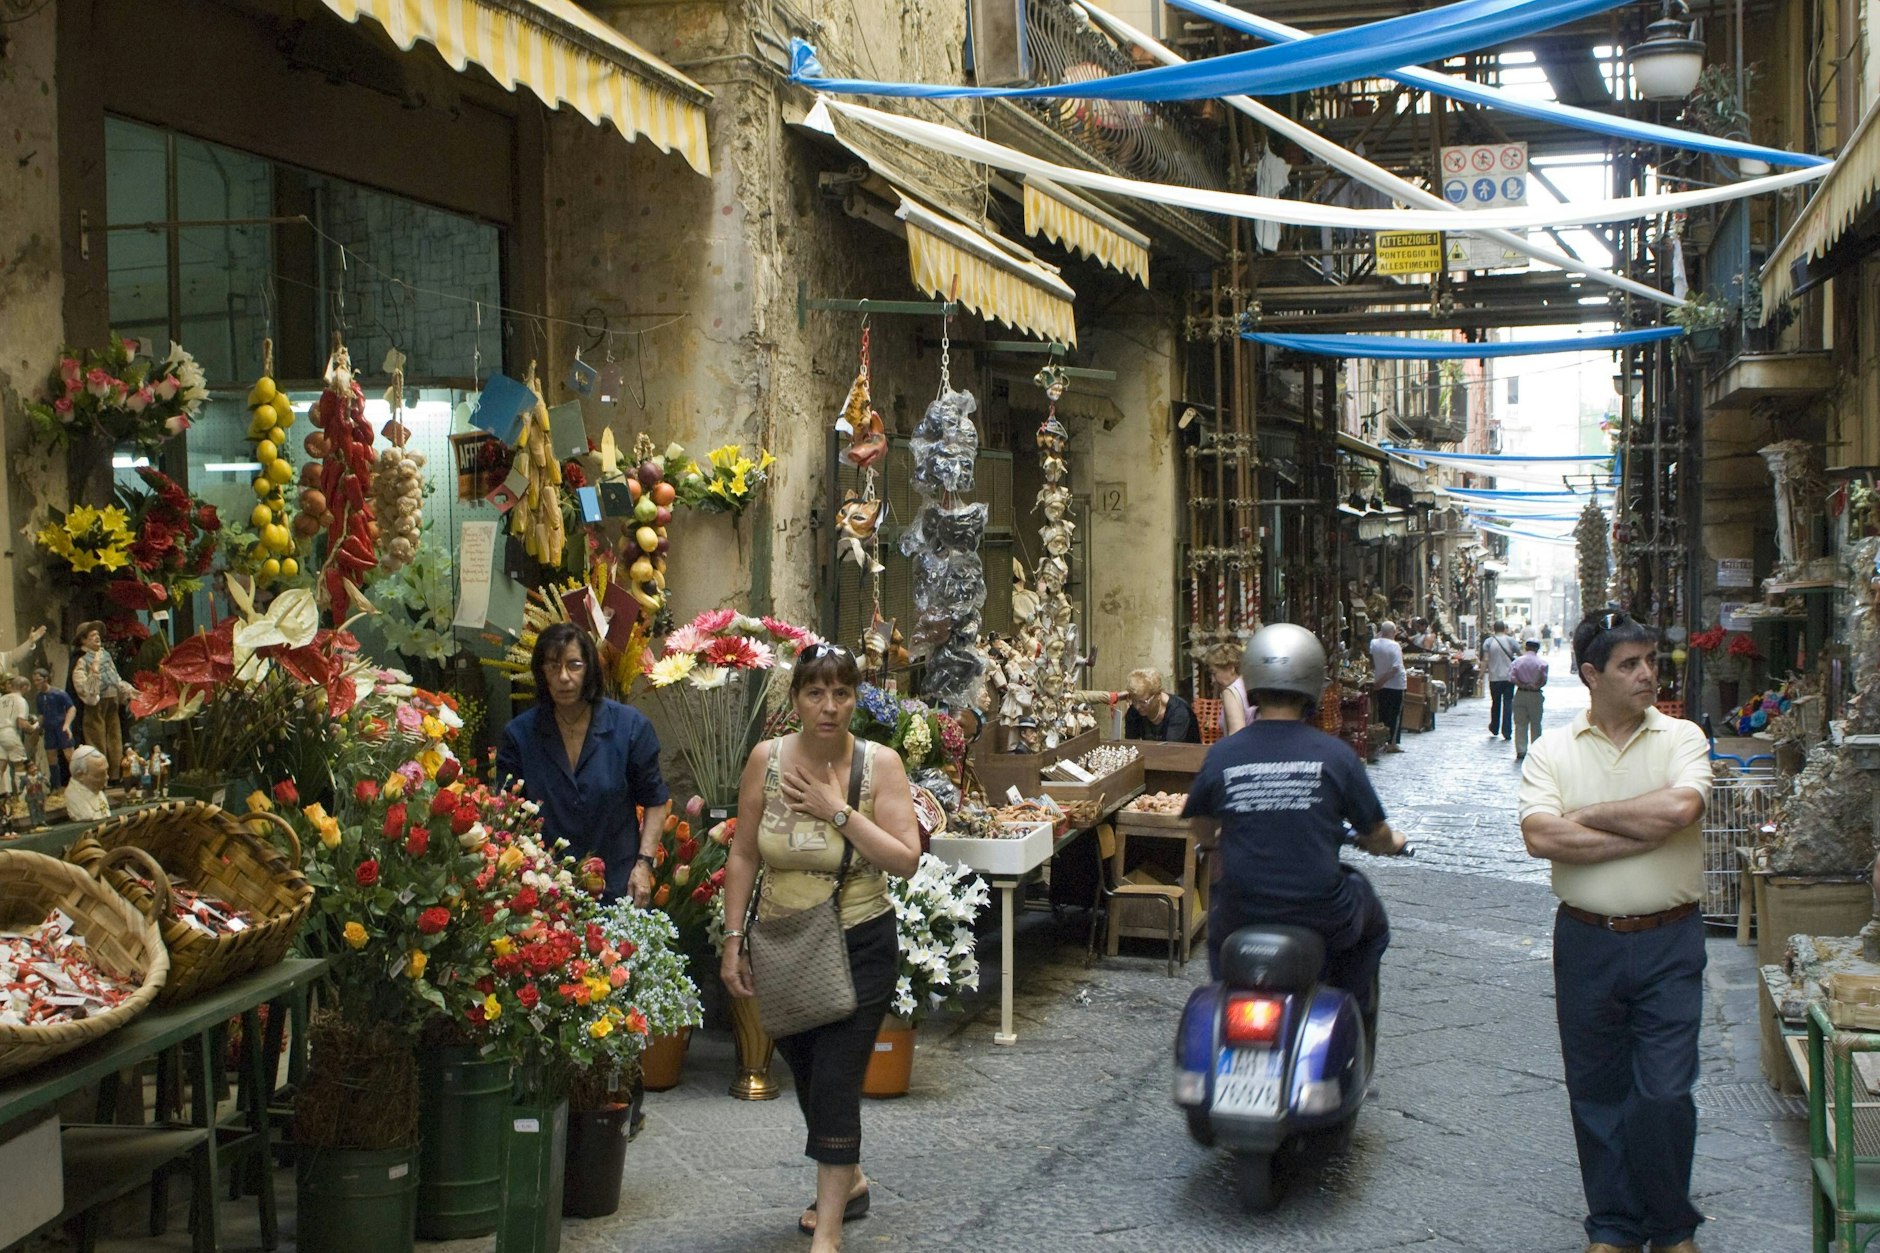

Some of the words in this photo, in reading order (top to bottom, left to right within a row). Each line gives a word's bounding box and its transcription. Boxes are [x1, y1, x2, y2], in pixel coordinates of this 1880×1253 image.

[1380, 250, 1426, 260] PONTEGGIO
[1430, 249, 1439, 257] IN
[1380, 260, 1440, 271] ALLESTIMENTO
[580, 307, 608, 353] 9
[1103, 490, 1121, 512] 12
